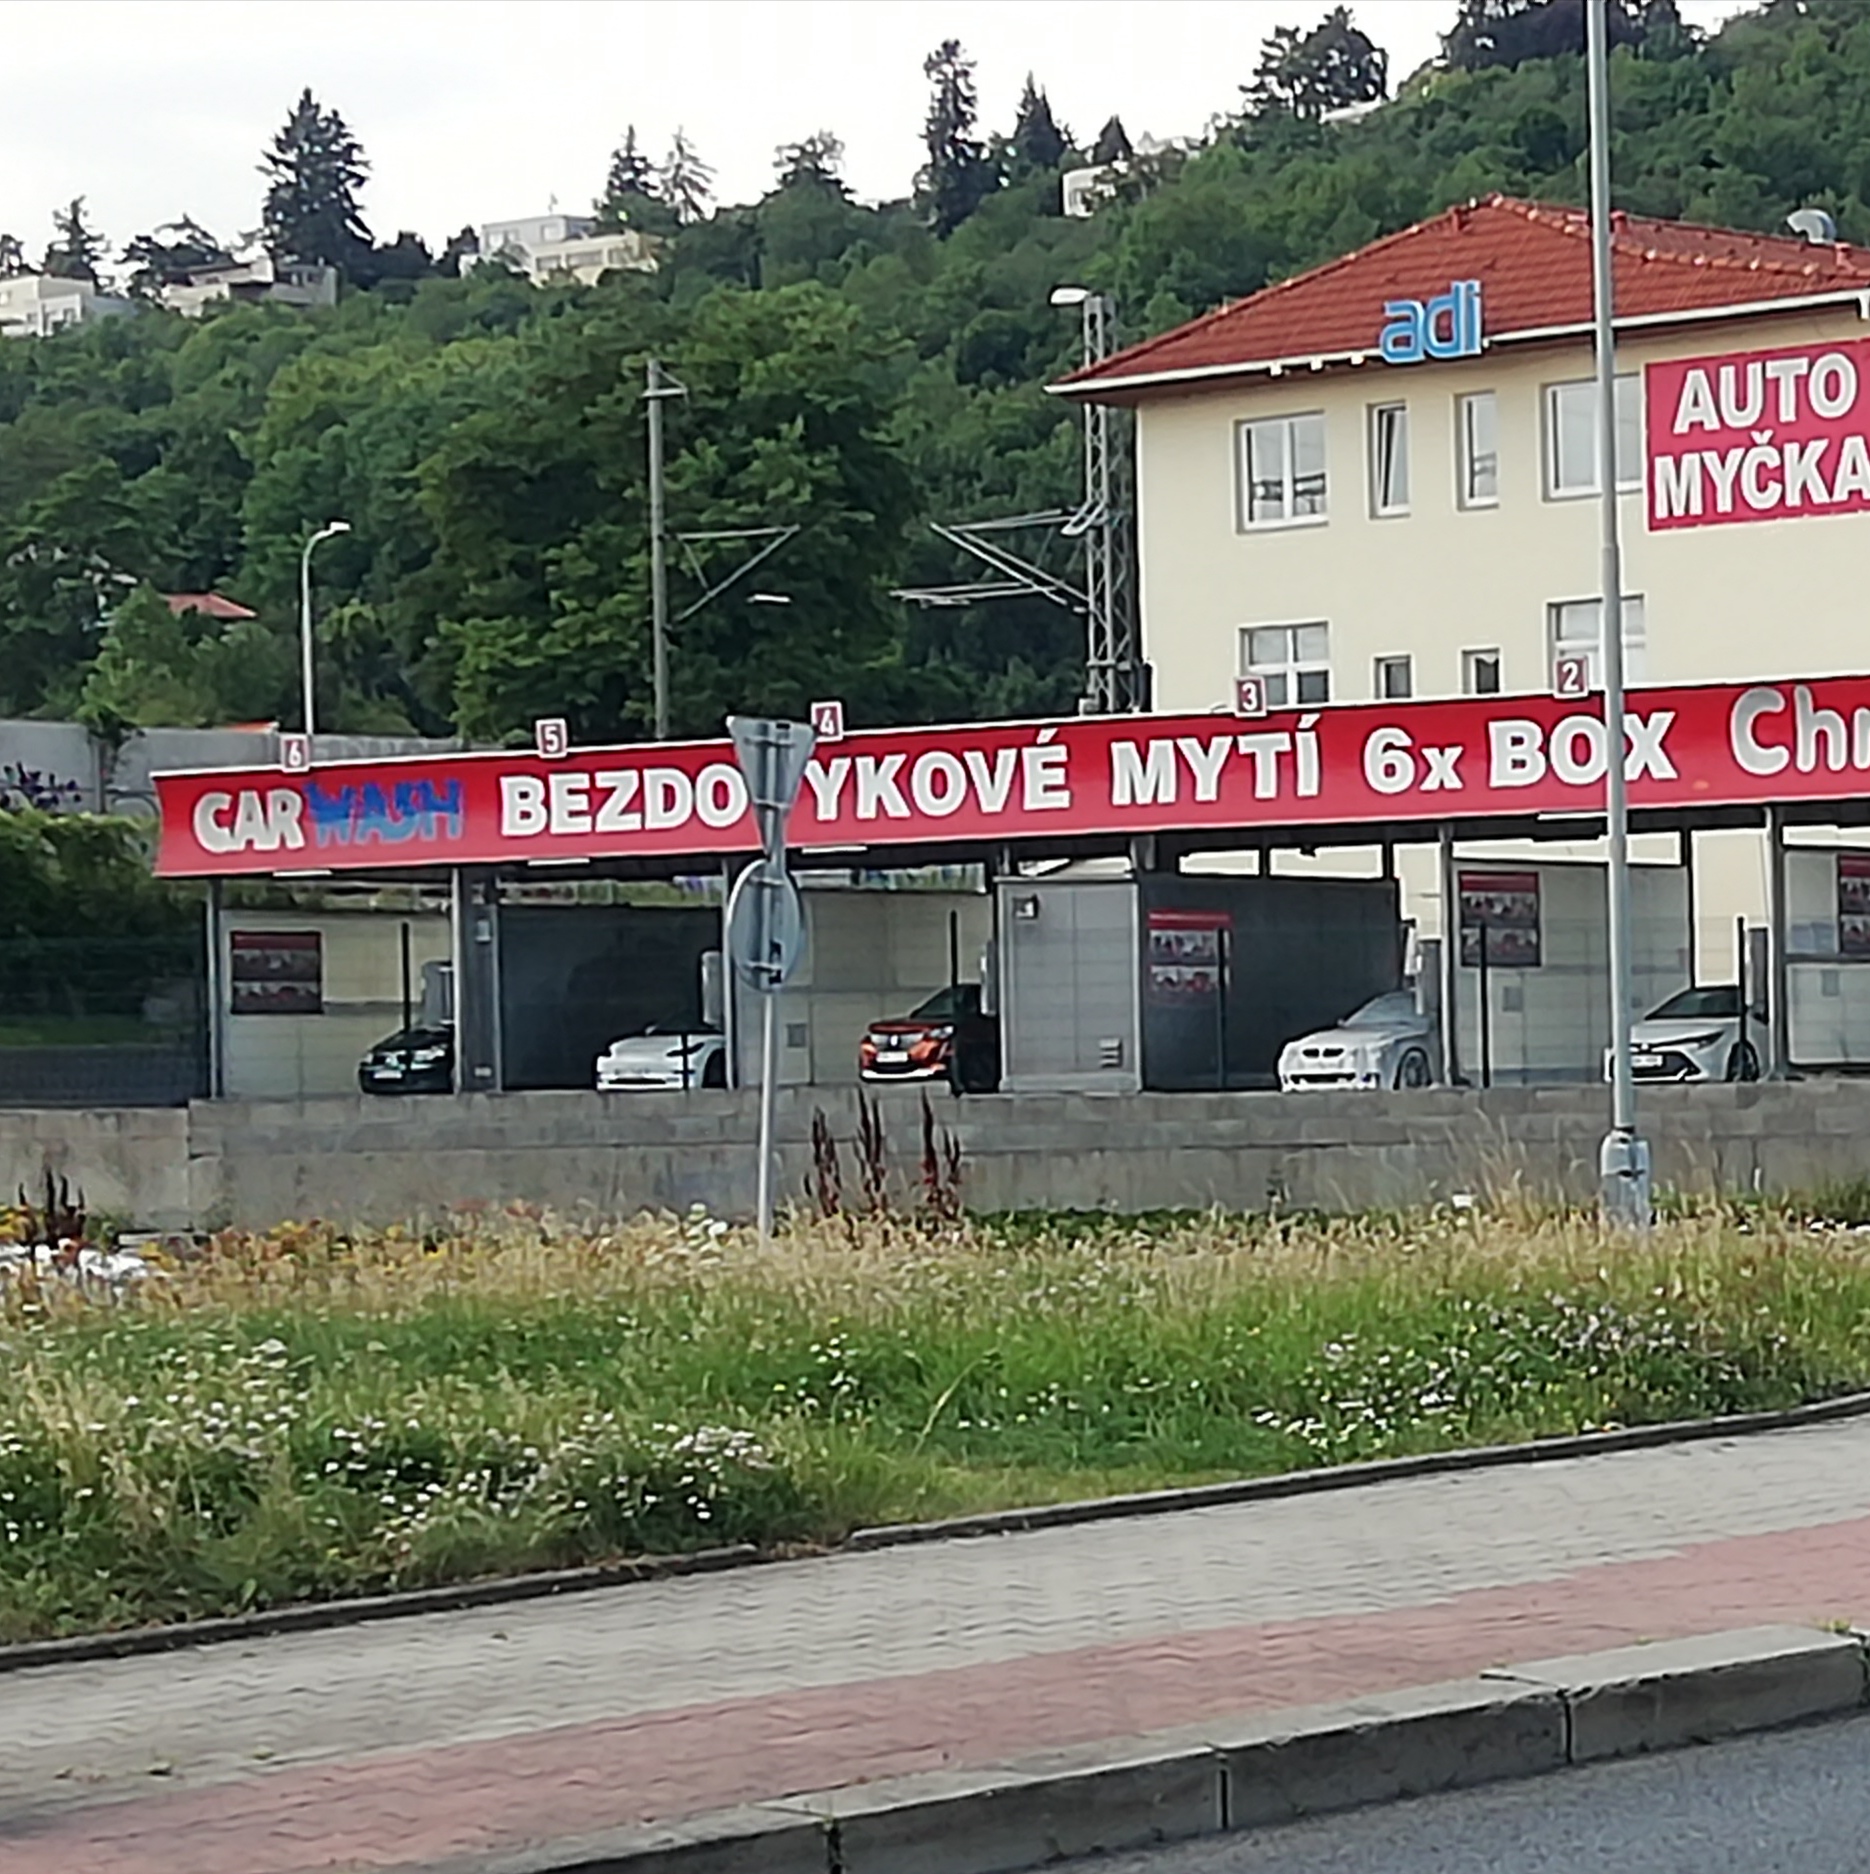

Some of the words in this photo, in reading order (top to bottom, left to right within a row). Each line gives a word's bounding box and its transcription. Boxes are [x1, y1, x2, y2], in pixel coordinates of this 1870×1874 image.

[1379, 280, 1482, 364] adi
[1673, 352, 1860, 434] AUTO
[1561, 662, 1579, 692] 2
[1242, 681, 1259, 711] 3
[819, 709, 836, 735] 4
[288, 743, 302, 766] 6
[545, 727, 560, 752] 5
[500, 728, 1071, 837] BEZDOYKOVÉ
[1111, 714, 1321, 806] MYTÍ
[1363, 726, 1463, 794] 6x
[1488, 710, 1678, 789] BOX
